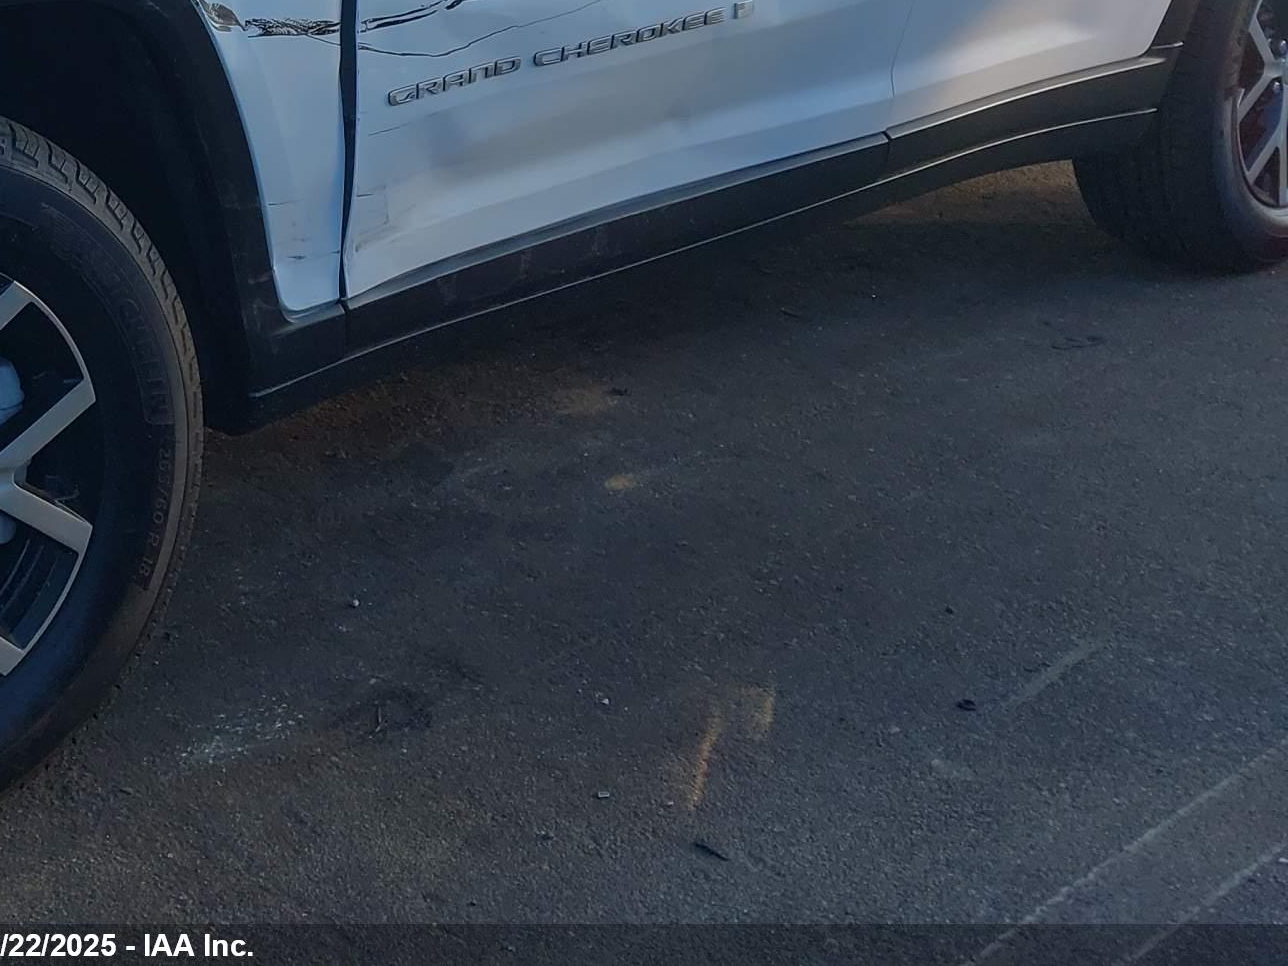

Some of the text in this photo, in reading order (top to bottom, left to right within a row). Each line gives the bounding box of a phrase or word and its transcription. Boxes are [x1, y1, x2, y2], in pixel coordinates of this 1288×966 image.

[386, 5, 728, 107] GRAND CHEROKEE
[144, 529, 162, 548] R
[137, 555, 156, 577] 18
